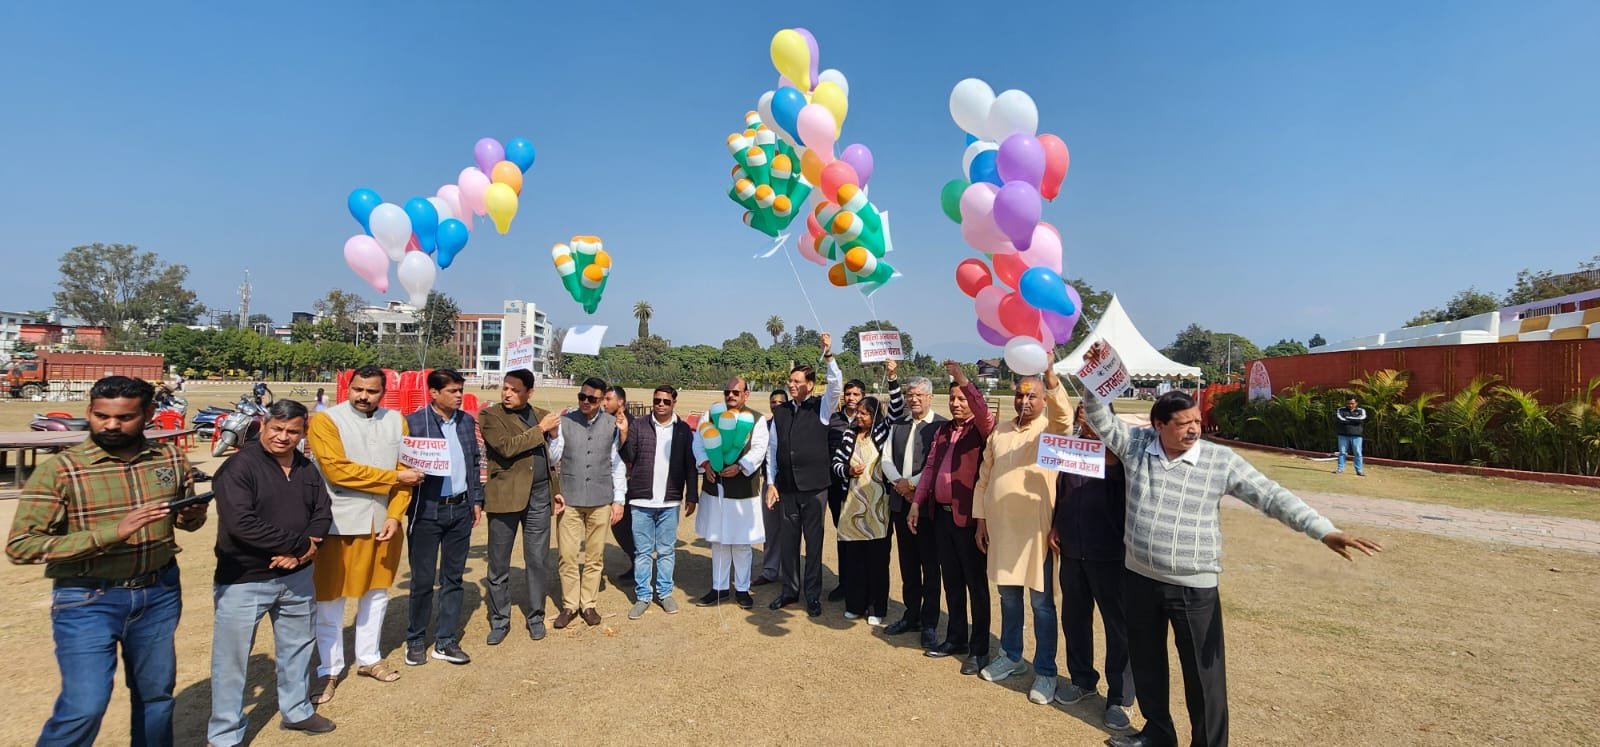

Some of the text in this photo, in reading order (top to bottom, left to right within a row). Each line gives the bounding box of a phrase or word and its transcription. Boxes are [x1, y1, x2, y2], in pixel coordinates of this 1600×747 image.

[403, 437, 448, 450] भ्रष्टाचार
[1043, 435, 1103, 453] भ्रष्टाचार
[401, 452, 449, 470] राजभवन घेराव
[1041, 455, 1100, 473] राजभवन घेराव
